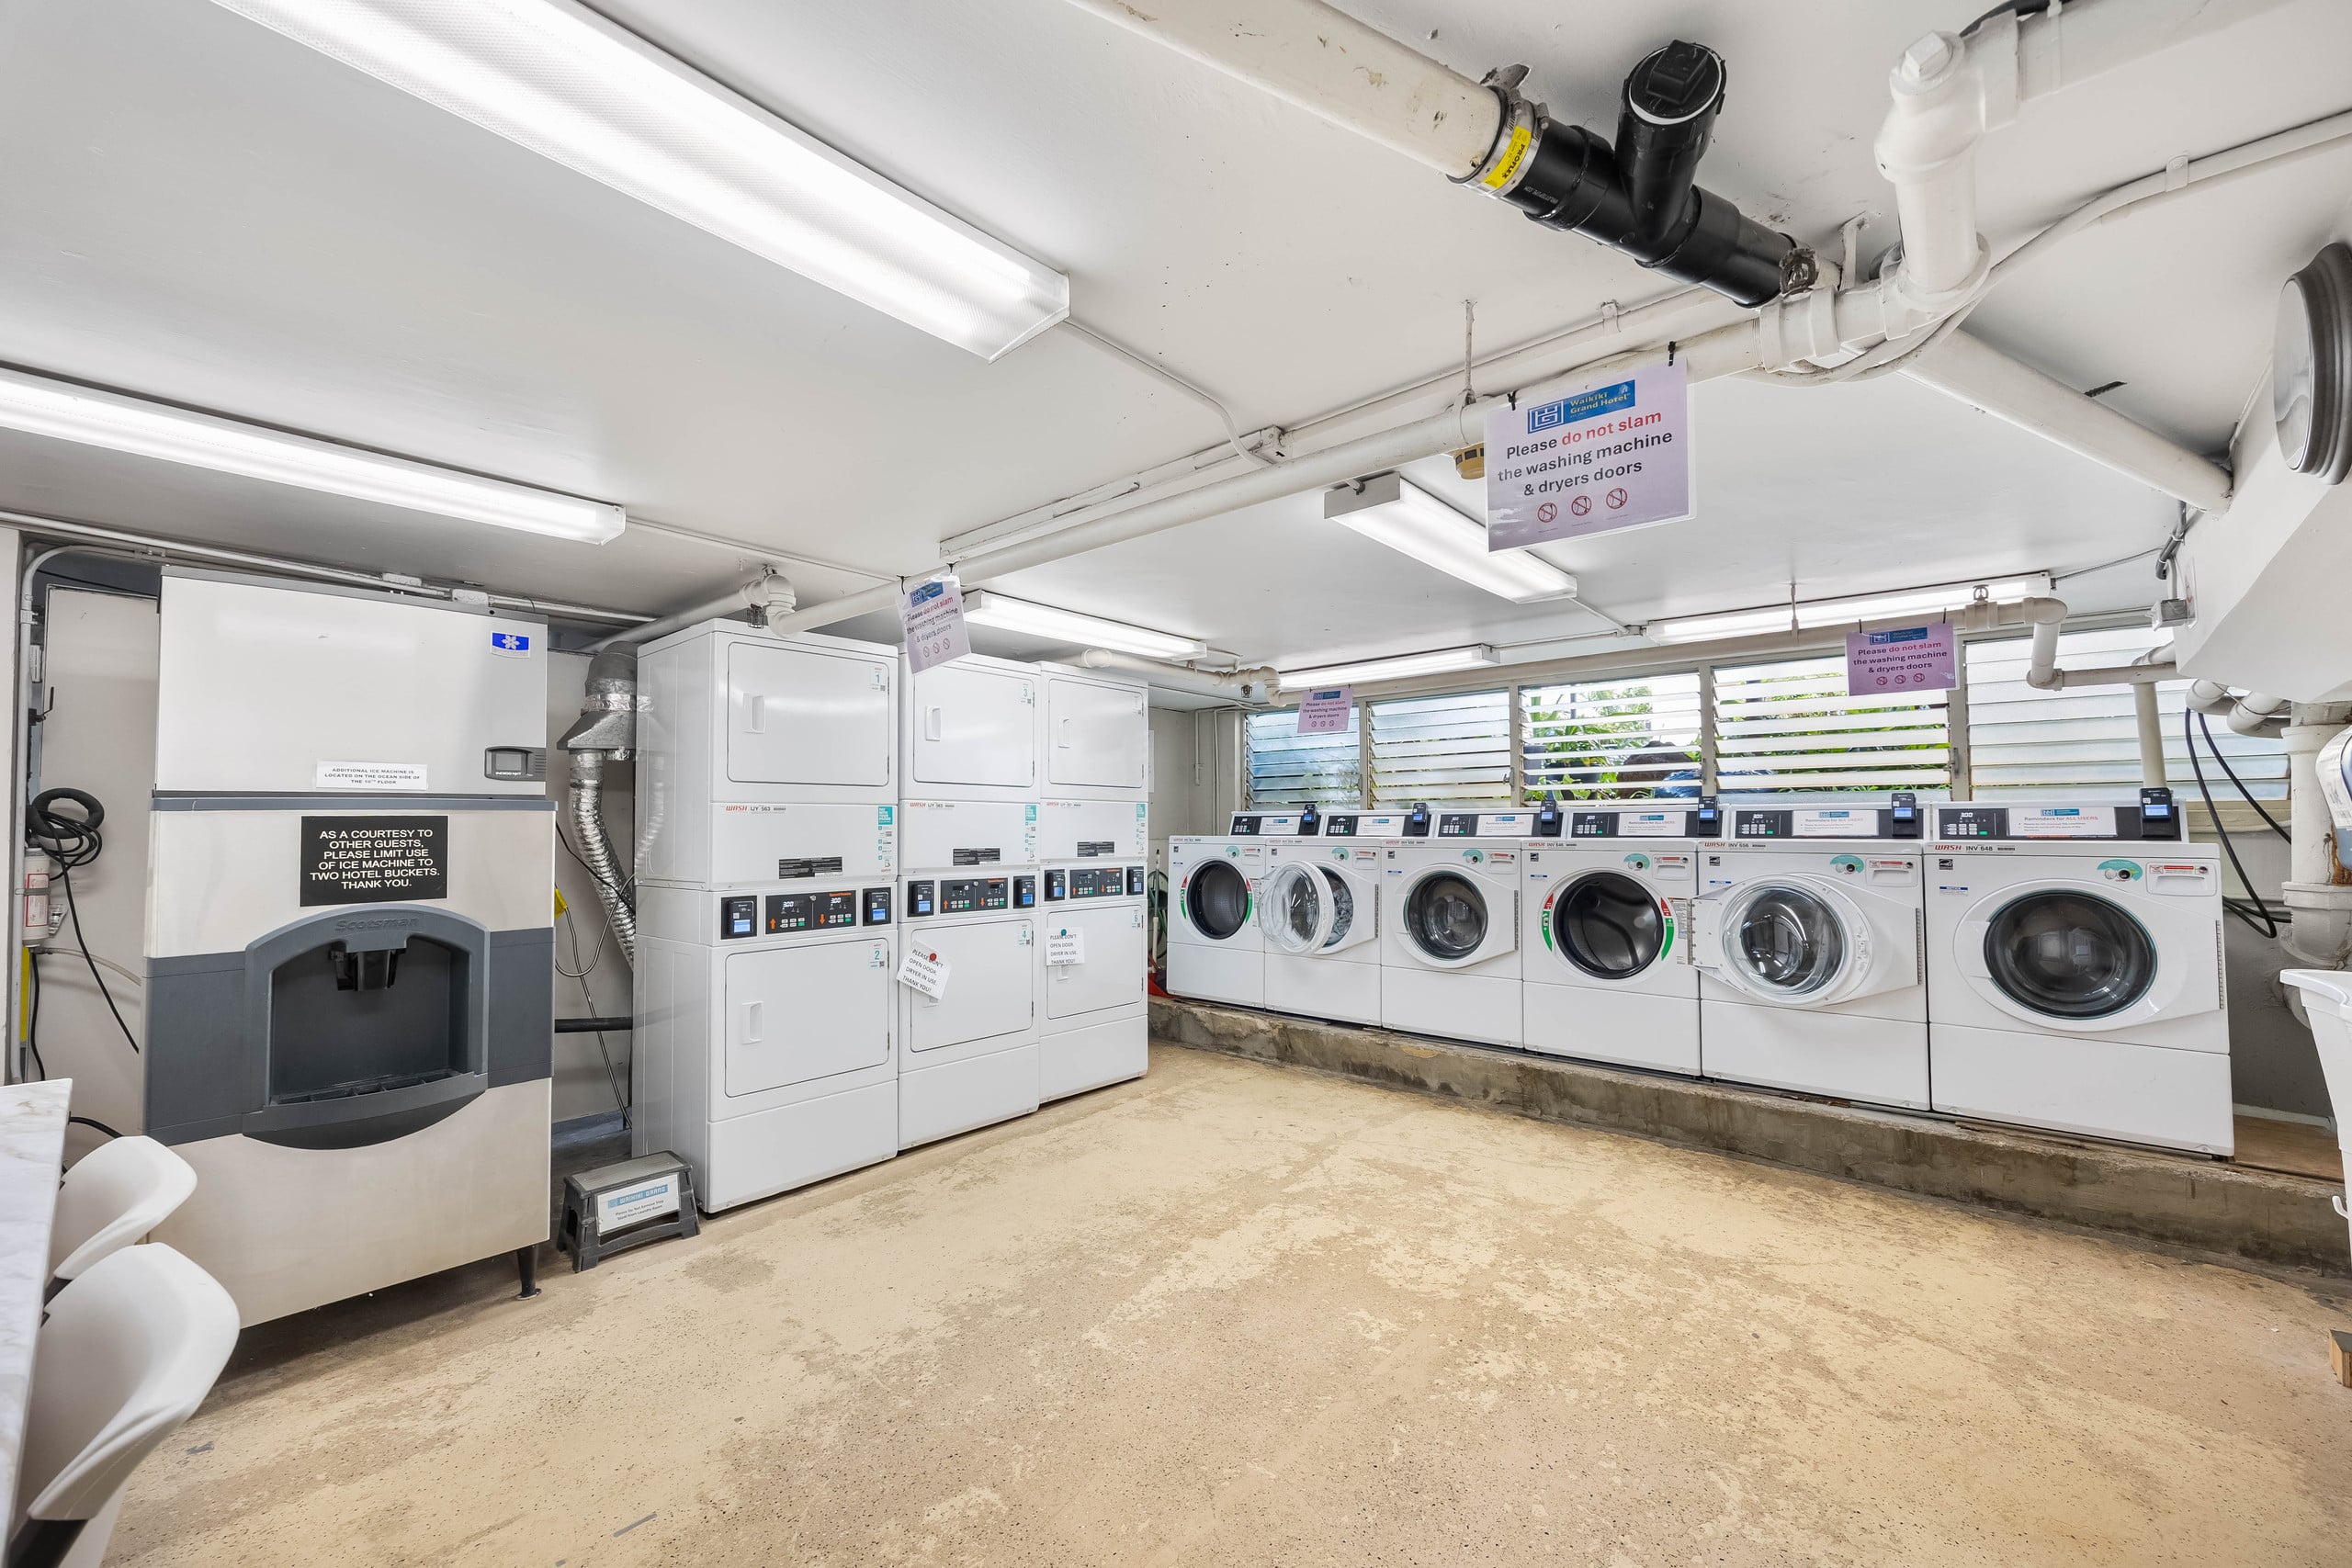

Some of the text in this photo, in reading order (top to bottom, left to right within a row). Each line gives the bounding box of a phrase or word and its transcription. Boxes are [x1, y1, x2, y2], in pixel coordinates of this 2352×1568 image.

[1502, 144, 1525, 179] PROFLEX
[1570, 391, 1608, 406] Waikiki
[1570, 394, 1628, 414] Grand Hotel
[1507, 412, 1662, 459] Please do not slam
[1498, 432, 1673, 482] the washing machine
[1523, 460, 1642, 496] & dryers doors
[907, 609, 923, 622] Please
[940, 597, 953, 608] slam
[936, 607, 958, 622] machine
[921, 630, 937, 640] dryers
[937, 624, 951, 635] doors
[1869, 655, 1906, 664] washing
[1908, 651, 1947, 660] machine
[319, 829, 434, 840] AS A COURTESY TO
[329, 840, 372, 849] OTHER
[323, 849, 429, 860] PLEASE LIMIT USE
[318, 858, 434, 870] OF ICE MACHINE TO
[310, 868, 440, 881] TWO HOTEL BUCKETS.
[341, 879, 412, 890] THANK YOU.
[335, 918, 419, 932] Scotsman
[875, 950, 880, 960] 2
[912, 948, 928, 961] PLEASE
[909, 958, 922, 968] OPEN
[906, 966, 922, 978] DRYER
[903, 975, 919, 987] THANK
